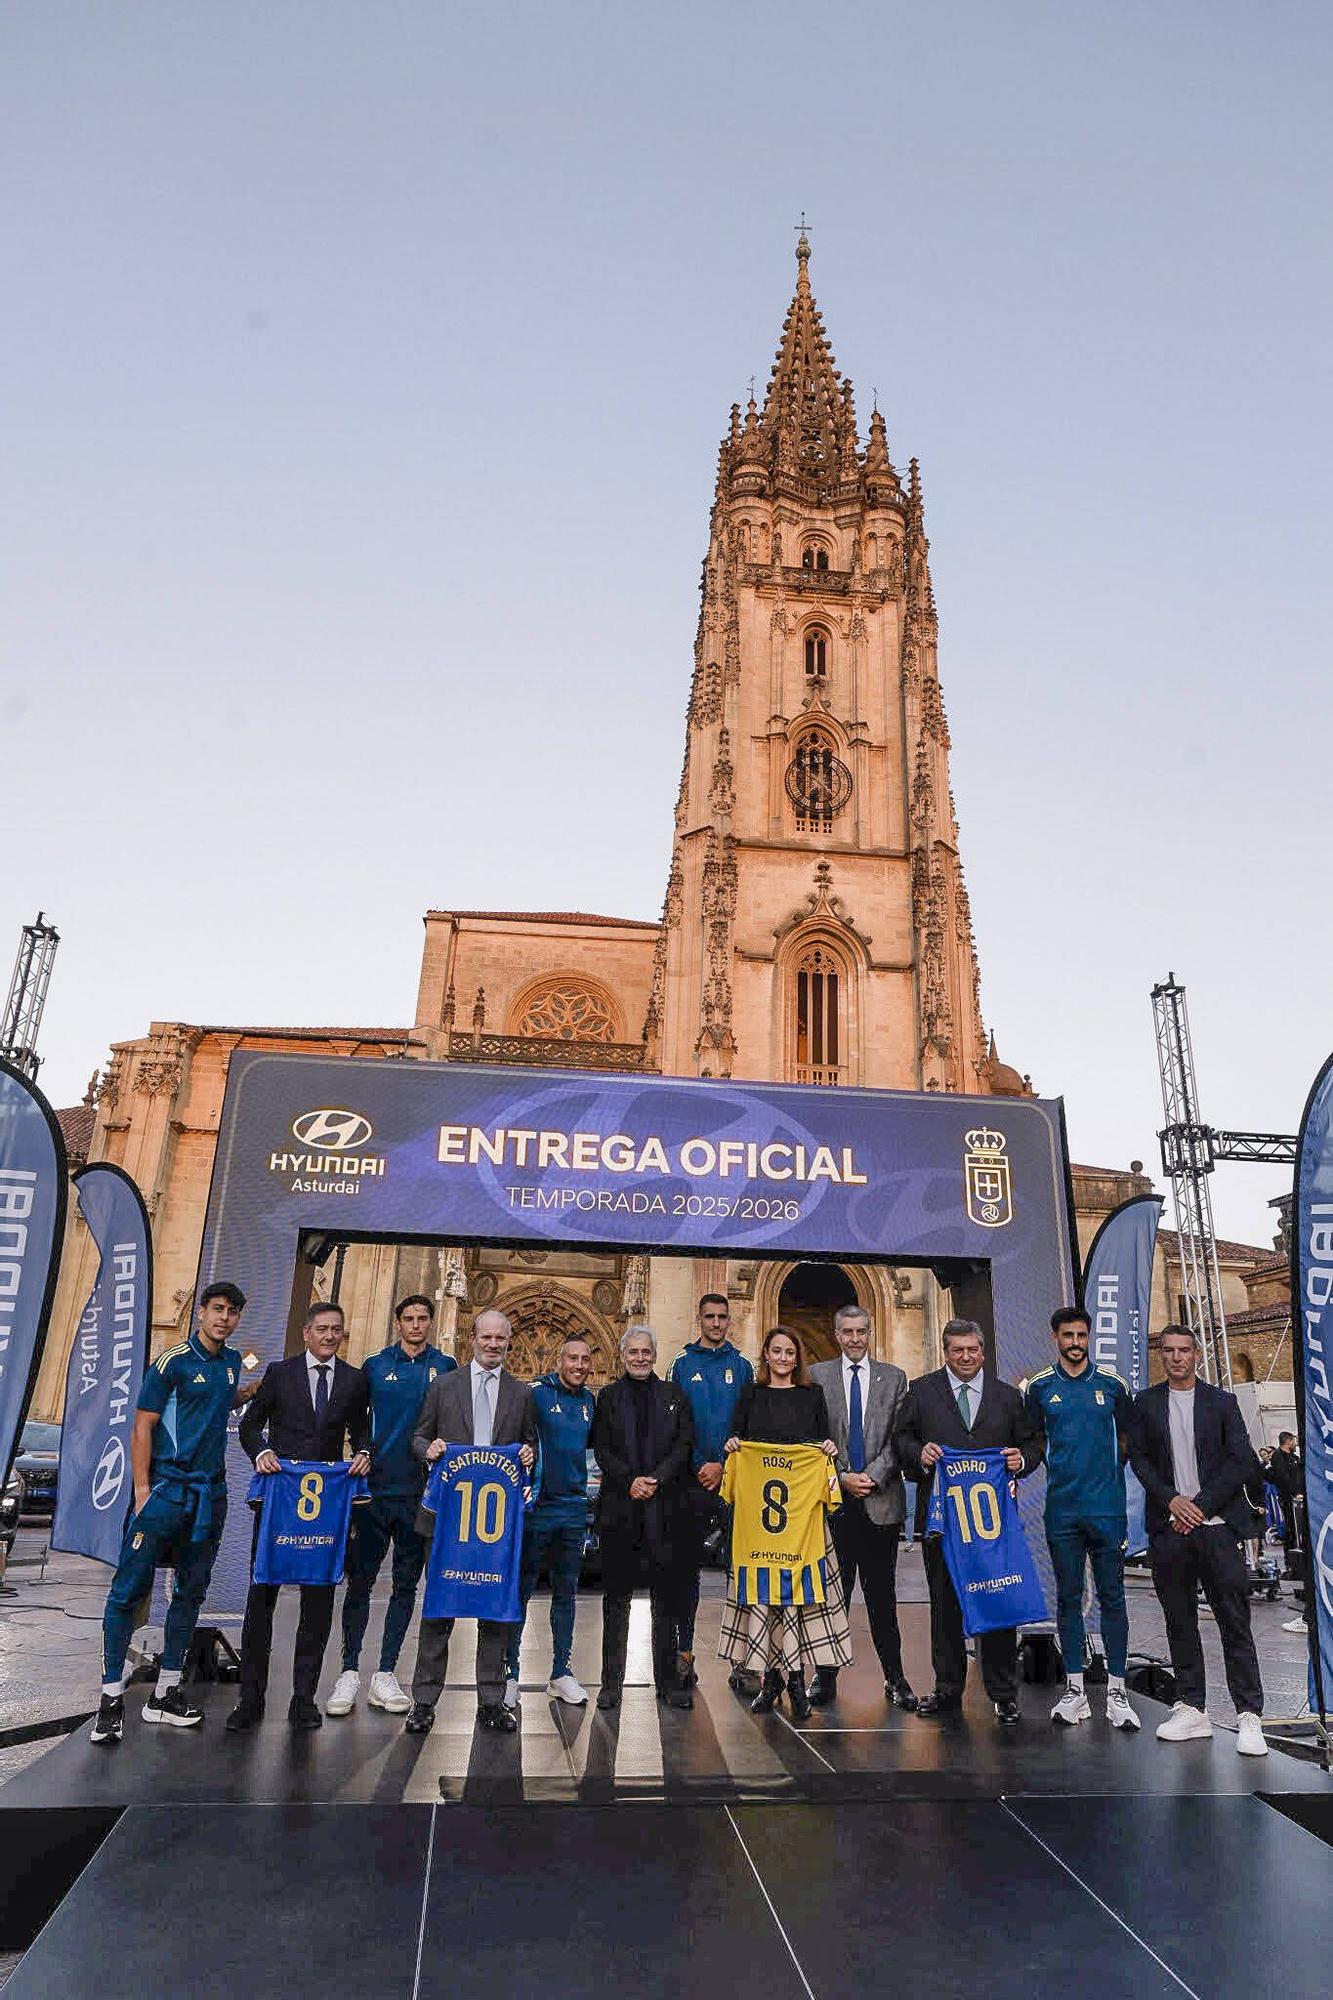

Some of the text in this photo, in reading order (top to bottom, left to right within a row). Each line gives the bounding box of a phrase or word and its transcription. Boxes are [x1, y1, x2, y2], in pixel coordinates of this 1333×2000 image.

[270, 1153, 385, 1176] HYUNDAI
[438, 1126, 868, 1183] ENTREGA OFICIAL
[291, 1178, 360, 1194] Asturdai
[506, 1186, 799, 1220] TEMPORADA 2025/2026
[762, 1456, 794, 1471] ROSA
[946, 1460, 987, 1477] CURRO
[297, 1472, 324, 1521] 8
[761, 1479, 788, 1535] 8
[454, 1481, 506, 1543] 10
[947, 1482, 1001, 1544] 10
[762, 1551, 803, 1561] HYUNDAI
[456, 1570, 502, 1583] HYUNDAI
[979, 1574, 1023, 1591] HYUNDAI
